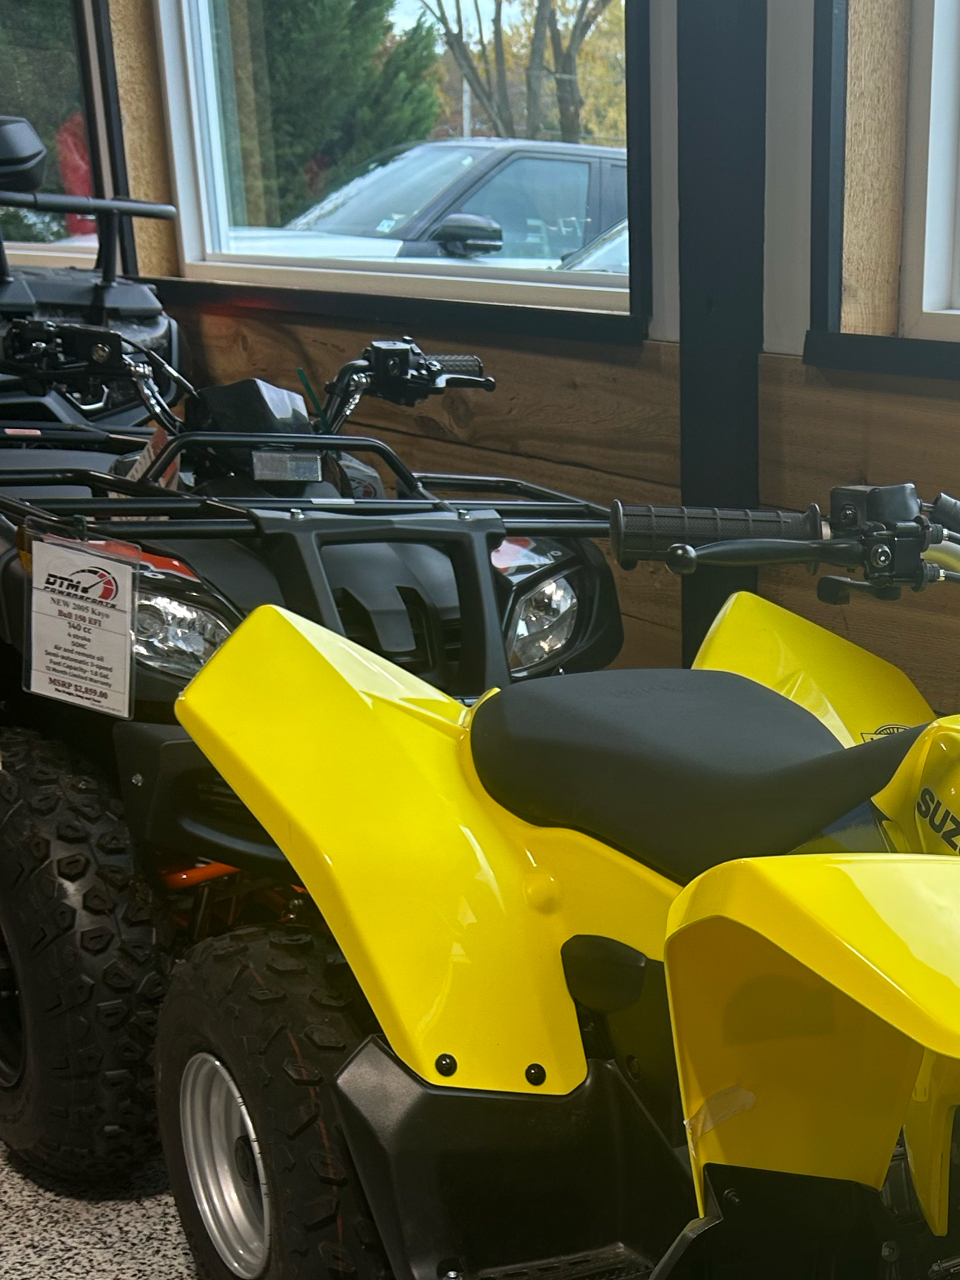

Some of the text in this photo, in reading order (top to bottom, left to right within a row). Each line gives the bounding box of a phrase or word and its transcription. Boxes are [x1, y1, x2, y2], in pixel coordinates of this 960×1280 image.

[44, 573, 81, 593] DTM
[43, 586, 117, 609] POWERSPORTS
[50, 597, 70, 609] NEW
[90, 607, 110, 620] Kayo
[83, 626, 92, 635] cc
[48, 677, 73, 690] MSRP
